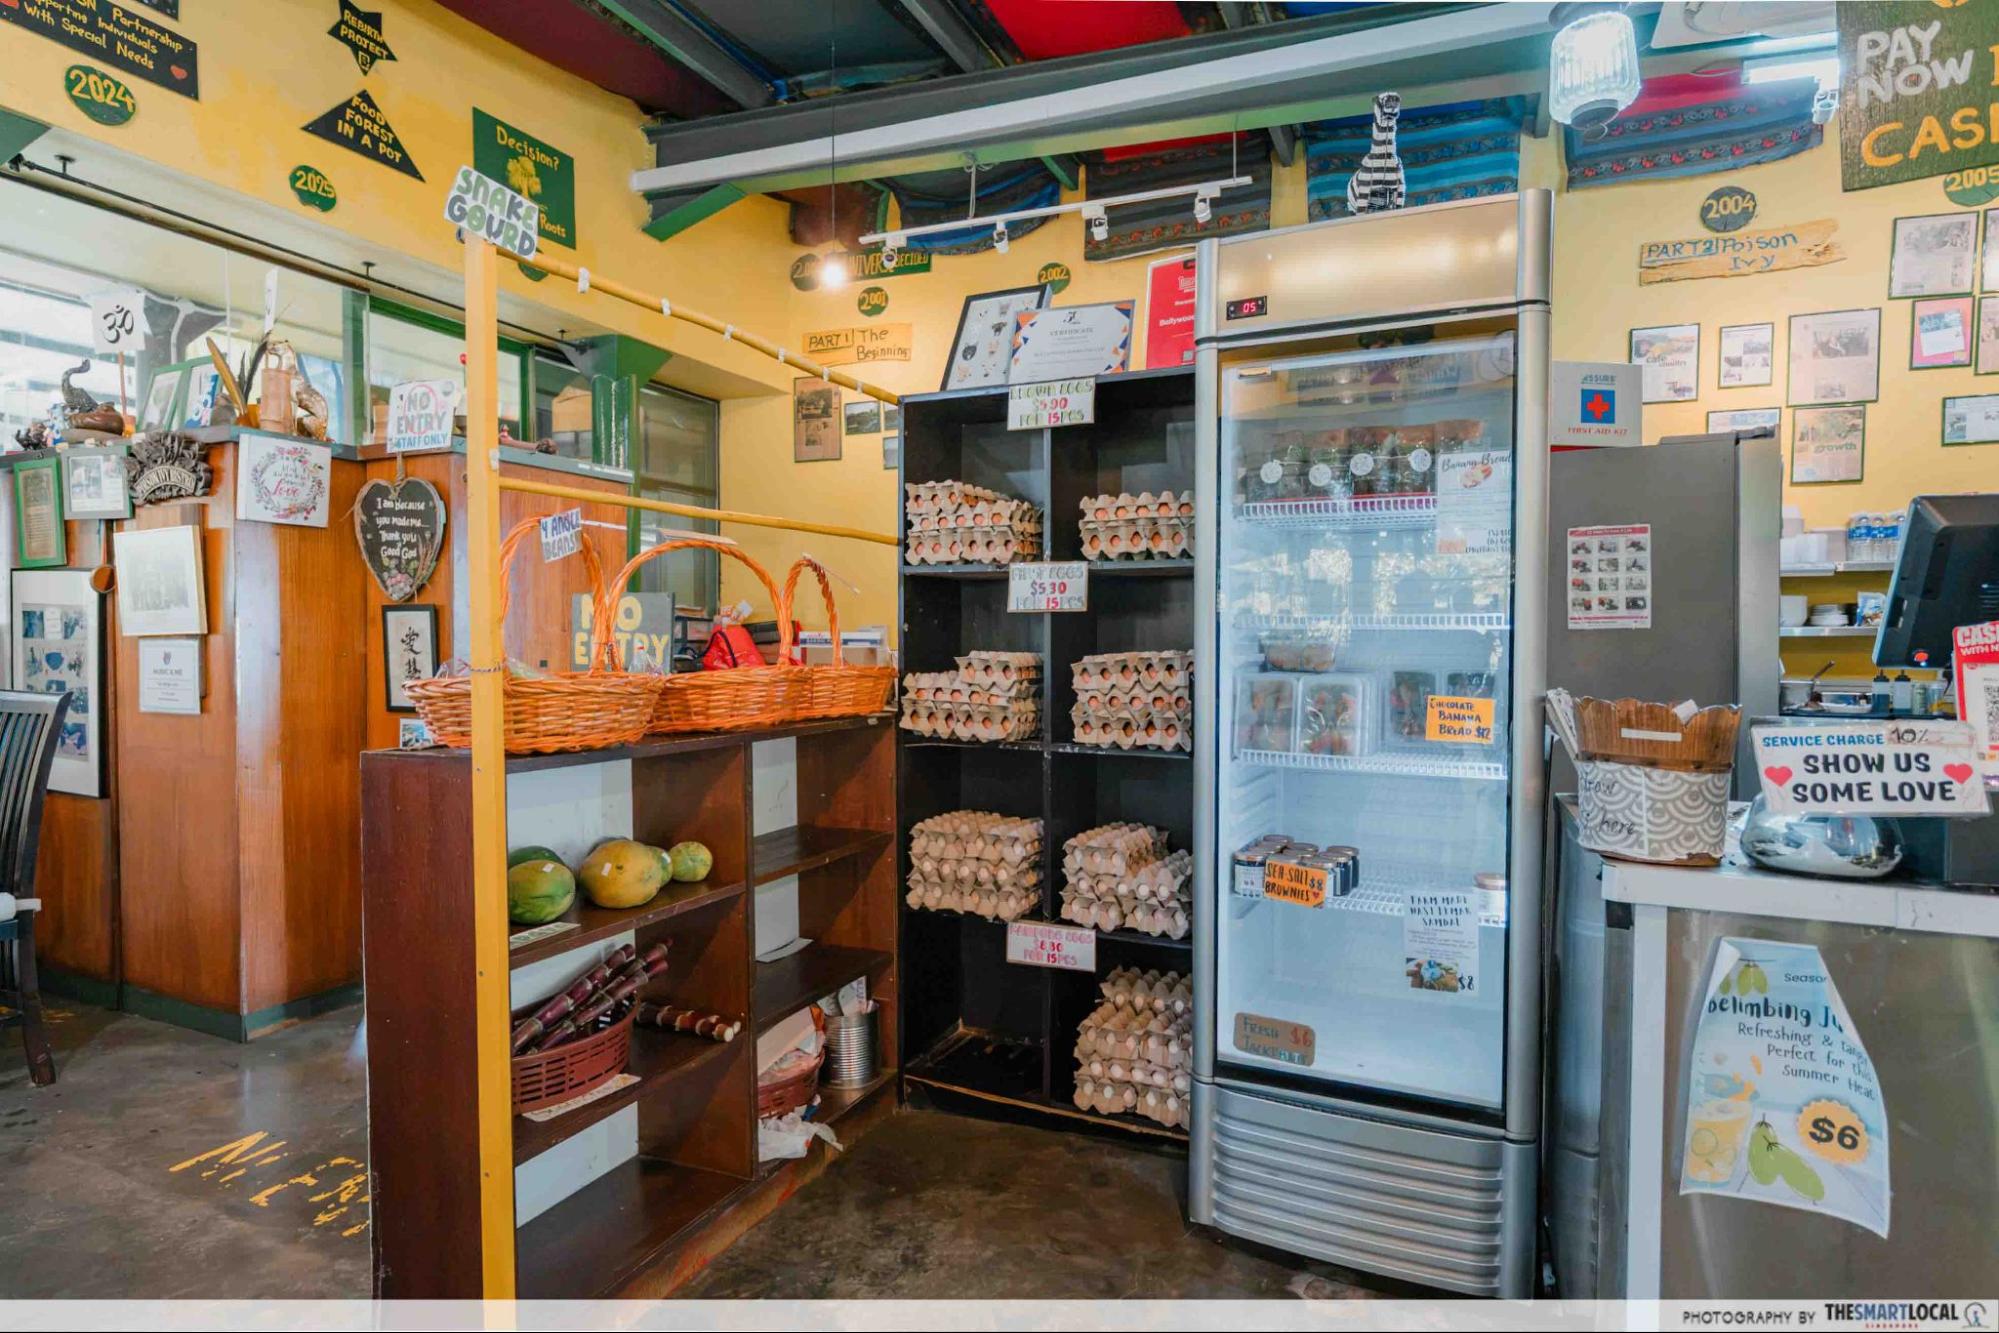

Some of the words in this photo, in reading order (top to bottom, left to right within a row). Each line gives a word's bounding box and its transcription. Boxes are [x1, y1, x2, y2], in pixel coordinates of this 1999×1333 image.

[24, 2, 55, 26] With
[62, 17, 107, 48] Special
[117, 41, 154, 69] Needs
[98, 17, 158, 54] Individuals
[113, 8, 183, 52] Partnership
[344, 9, 384, 43] REBIRTH
[340, 24, 388, 60] PROJECT
[1856, 19, 1942, 74] PAY
[1857, 49, 1974, 109] NOW
[70, 69, 134, 112] 2024
[345, 107, 394, 144] FOREST
[337, 119, 355, 139] IN
[361, 134, 372, 149] A
[379, 142, 401, 164] POT
[496, 125, 560, 172] Decision?
[295, 169, 335, 199] 2025
[1704, 194, 1754, 219] 2004
[447, 194, 536, 256] GOURD
[540, 213, 566, 238] Roots
[1648, 240, 1698, 258] PART
[1723, 232, 1798, 254] Poison
[1731, 254, 1776, 271] Ivy
[860, 290, 888, 310] 2001
[1242, 302, 1257, 313] 05
[808, 334, 841, 349] PART
[857, 329, 889, 342] The
[856, 345, 909, 361] Beginning
[407, 391, 430, 411] NO
[396, 411, 447, 436] ENTRY
[1594, 427, 1612, 435] AID
[1613, 428, 1628, 436] KIT
[396, 434, 422, 449] STAFF
[423, 432, 448, 445] ONLY
[376, 498, 383, 509] I
[383, 500, 394, 509] am
[394, 499, 425, 511] because
[375, 517, 390, 529] you
[392, 516, 410, 526] made
[379, 530, 400, 543] Thank
[401, 531, 417, 545] you
[380, 544, 400, 558] Good
[401, 547, 418, 559] God
[1961, 645, 1989, 656] WITH
[1438, 710, 1482, 723] BANANA
[1439, 724, 1472, 735] BREAD
[1762, 734, 1823, 748] SERVICE
[1827, 733, 1885, 746] CHARGE
[1890, 727, 1929, 743] 10%
[1803, 752, 1885, 774] SHOW
[1894, 752, 1931, 772] US
[1792, 781, 1873, 803] SOME
[1882, 780, 1956, 802] LOVE
[1265, 880, 1310, 902] BROWNIES
[1309, 876, 1323, 891] $8
[1290, 1026, 1313, 1048] $6
[1738, 1022, 1813, 1046] Refreshing
[1822, 1034, 1833, 1047] &
[1767, 1043, 1817, 1062] Perfect
[1827, 1051, 1845, 1069] for
[1782, 1065, 1840, 1084] Summer
[1808, 1115, 1861, 1151] $6
